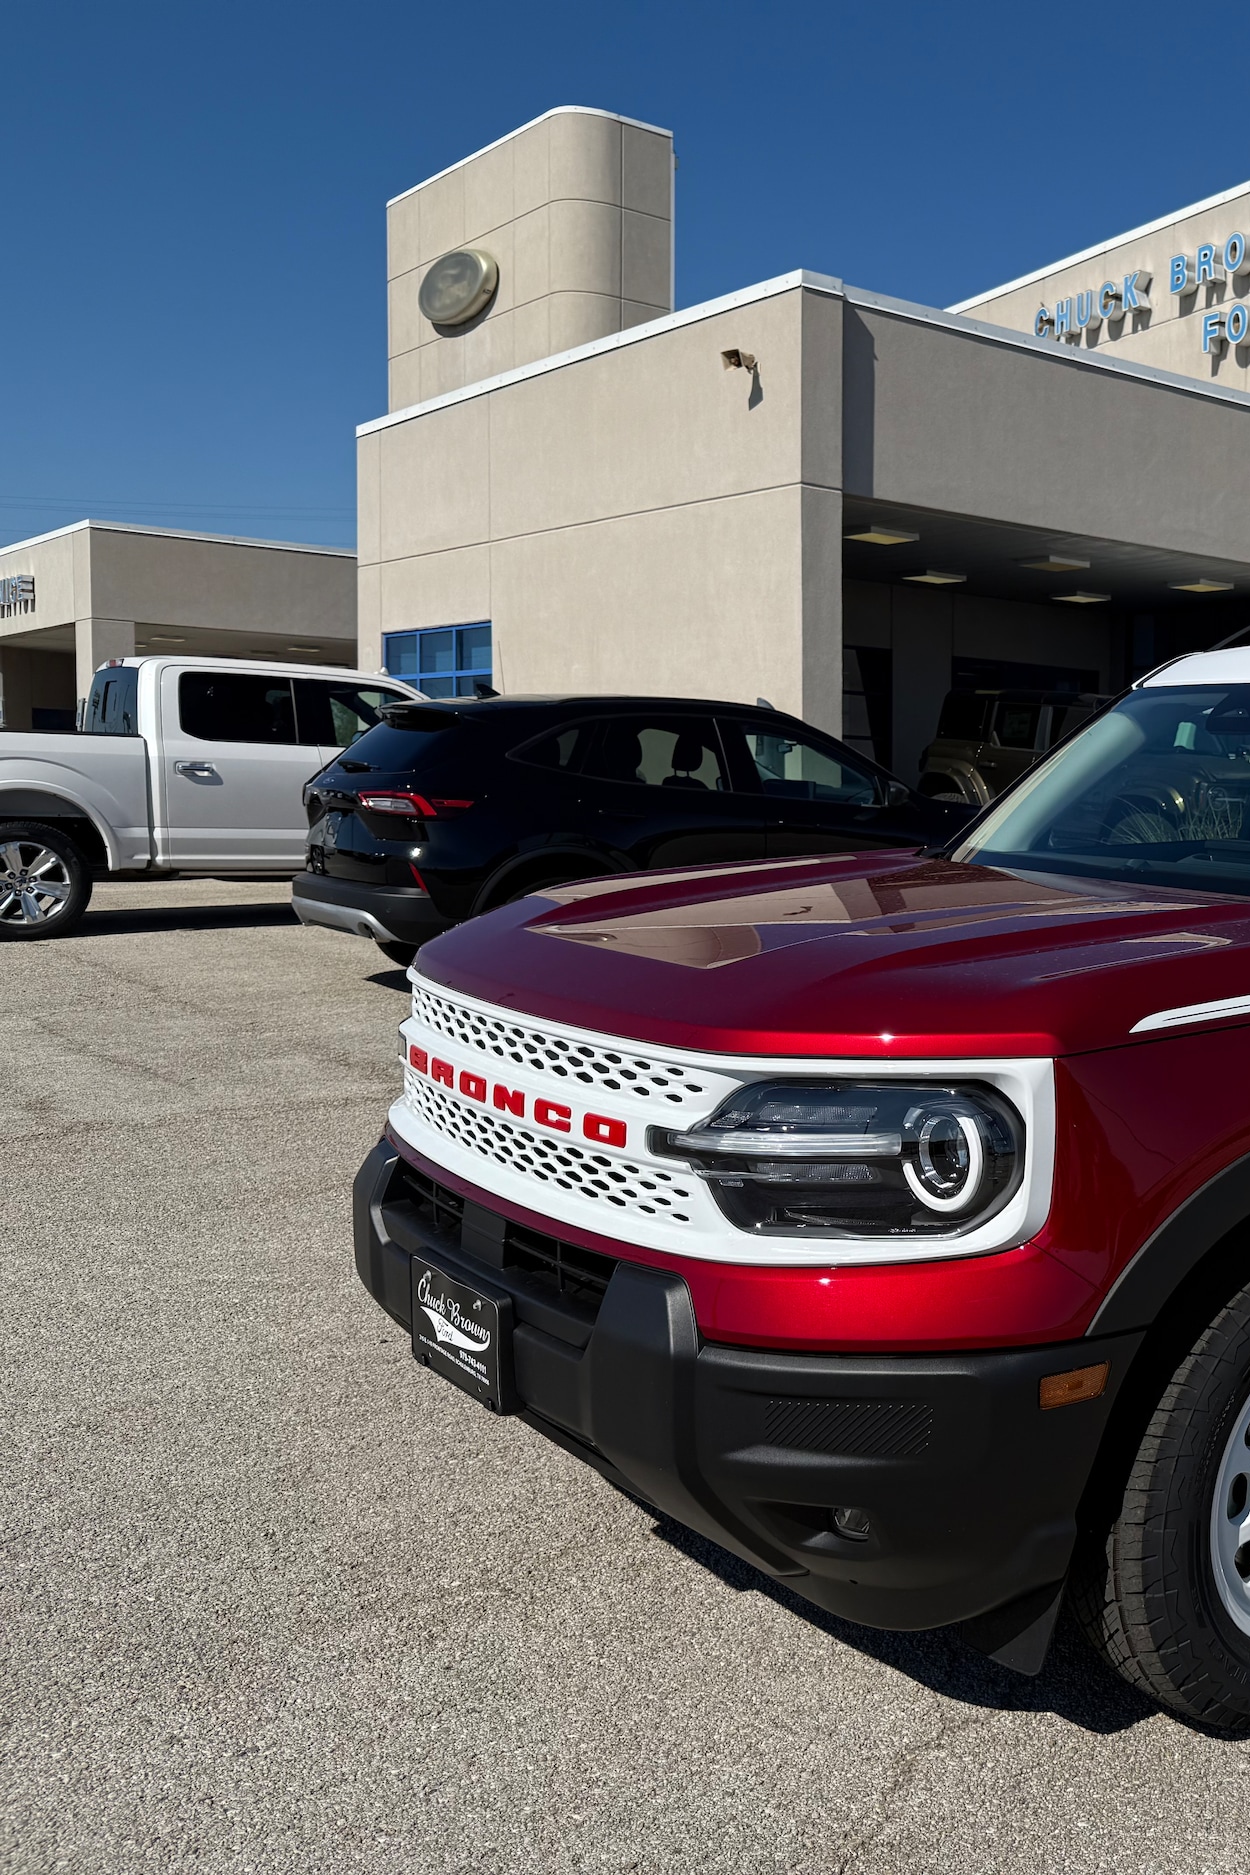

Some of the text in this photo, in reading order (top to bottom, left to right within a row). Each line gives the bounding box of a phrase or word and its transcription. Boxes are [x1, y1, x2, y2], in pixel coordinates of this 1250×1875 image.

[1034, 270, 1149, 338] CHUCK
[409, 1044, 628, 1149] BRONCO
[418, 1278, 490, 1342] Chuck Brown
